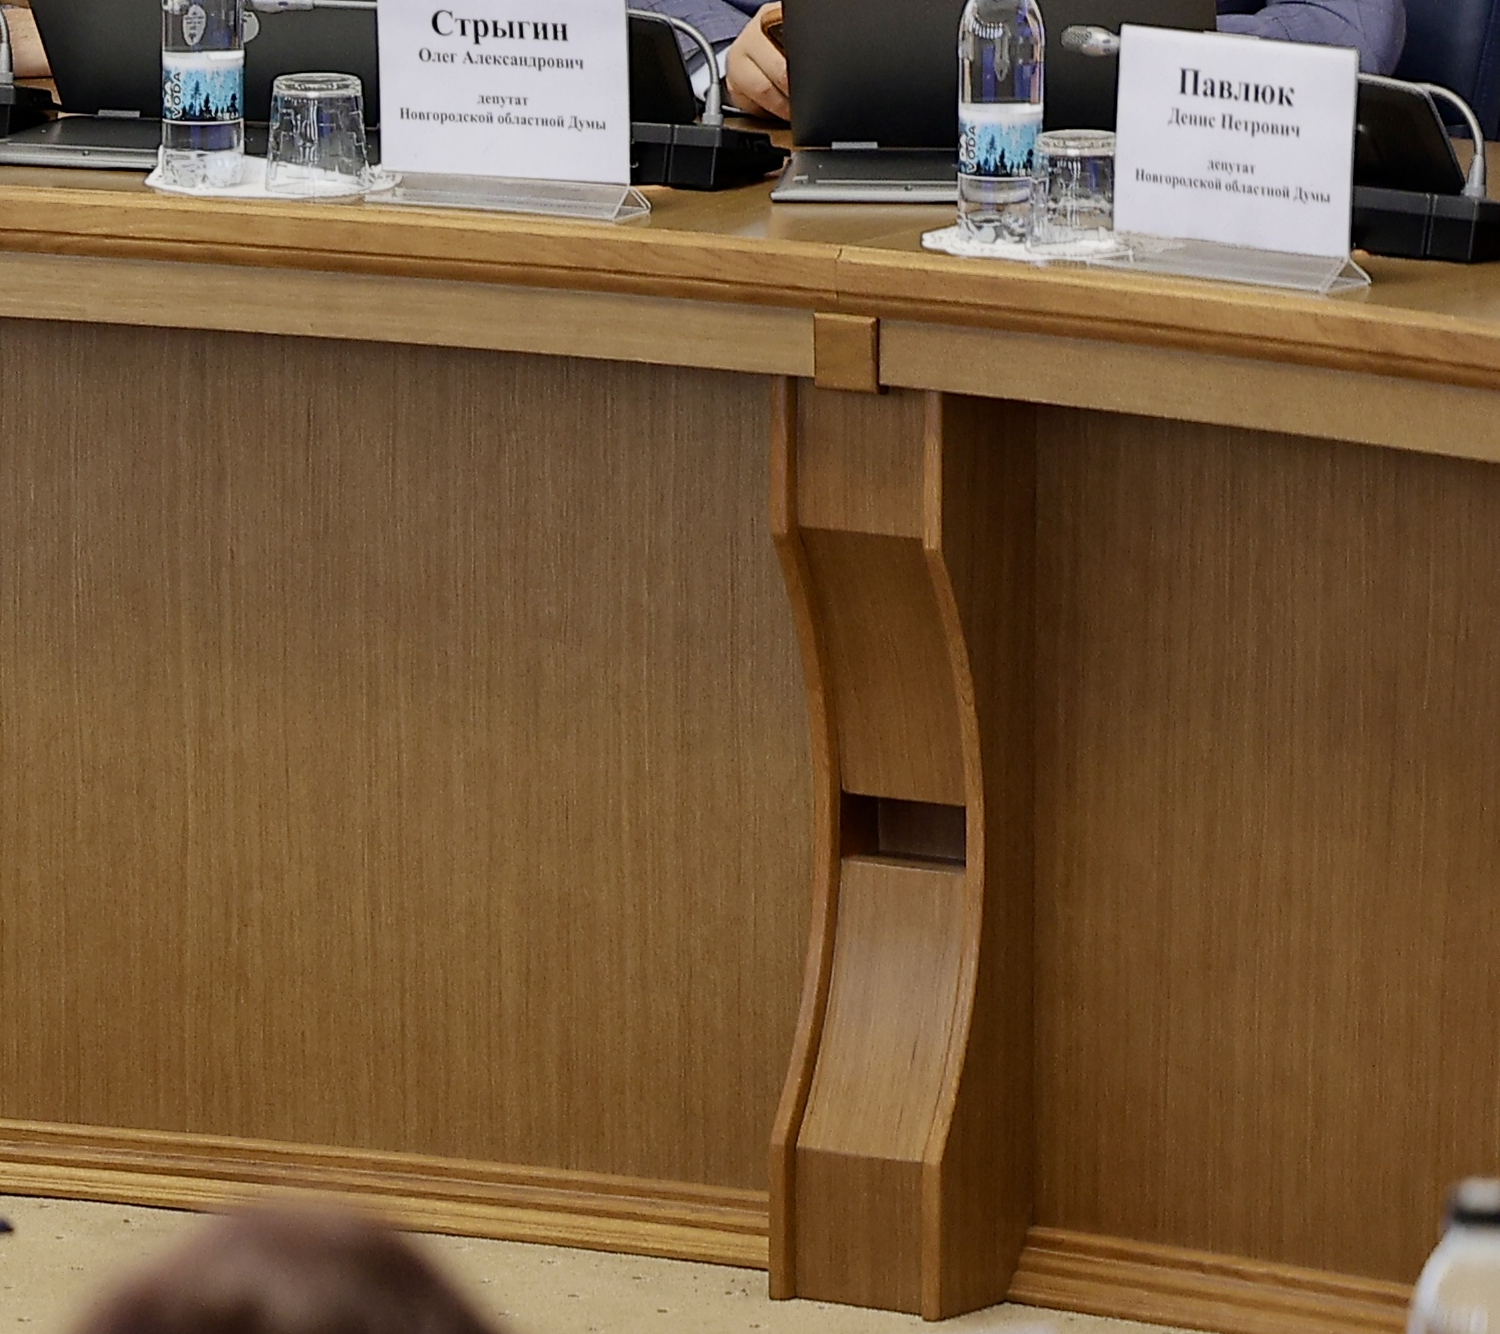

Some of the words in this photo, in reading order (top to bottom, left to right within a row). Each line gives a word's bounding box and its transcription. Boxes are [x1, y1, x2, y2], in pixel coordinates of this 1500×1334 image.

[431, 9, 569, 45] Стрыгин
[418, 47, 458, 64] Олег
[462, 50, 584, 71] Александрович
[173, 71, 182, 118] VODA
[477, 94, 529, 108] депутат
[1178, 67, 1295, 108] Павлюк
[399, 107, 494, 124] Новгородской
[497, 111, 565, 128] областной
[568, 115, 607, 132] Думы
[1167, 107, 1216, 129] Денис
[1221, 113, 1300, 139] Петрович
[967, 126, 976, 172] VODA
[1207, 159, 1256, 175] депутат
[1135, 168, 1222, 191] Новгородской
[1225, 179, 1290, 200] областной
[1293, 187, 1331, 205] Думы
